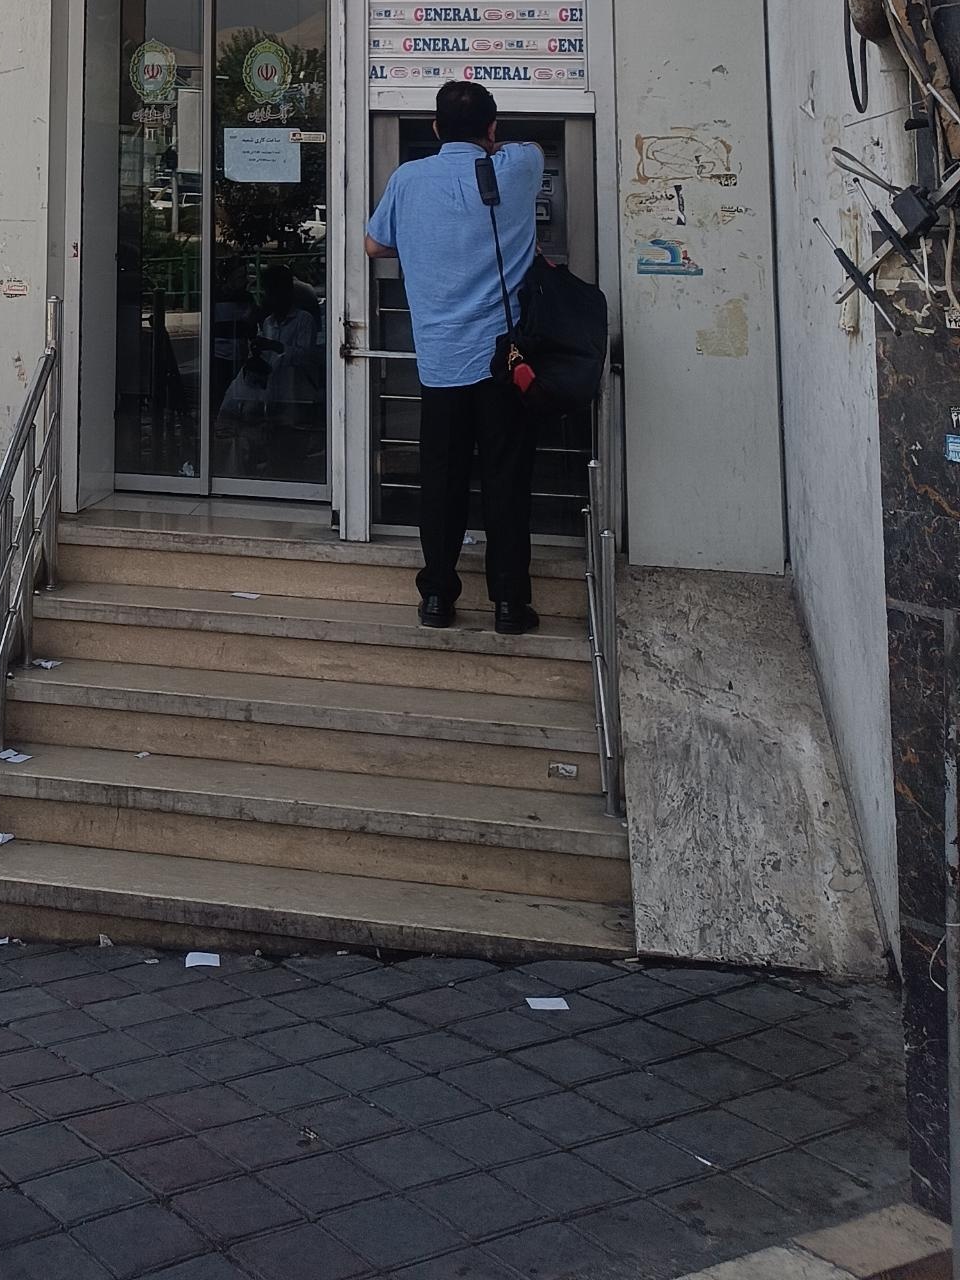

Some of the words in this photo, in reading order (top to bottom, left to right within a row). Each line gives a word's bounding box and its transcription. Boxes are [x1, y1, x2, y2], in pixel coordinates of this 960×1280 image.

[414, 7, 481, 22] GENERAL
[402, 37, 470, 52] GENERAL
[463, 66, 531, 81] GENERAL
